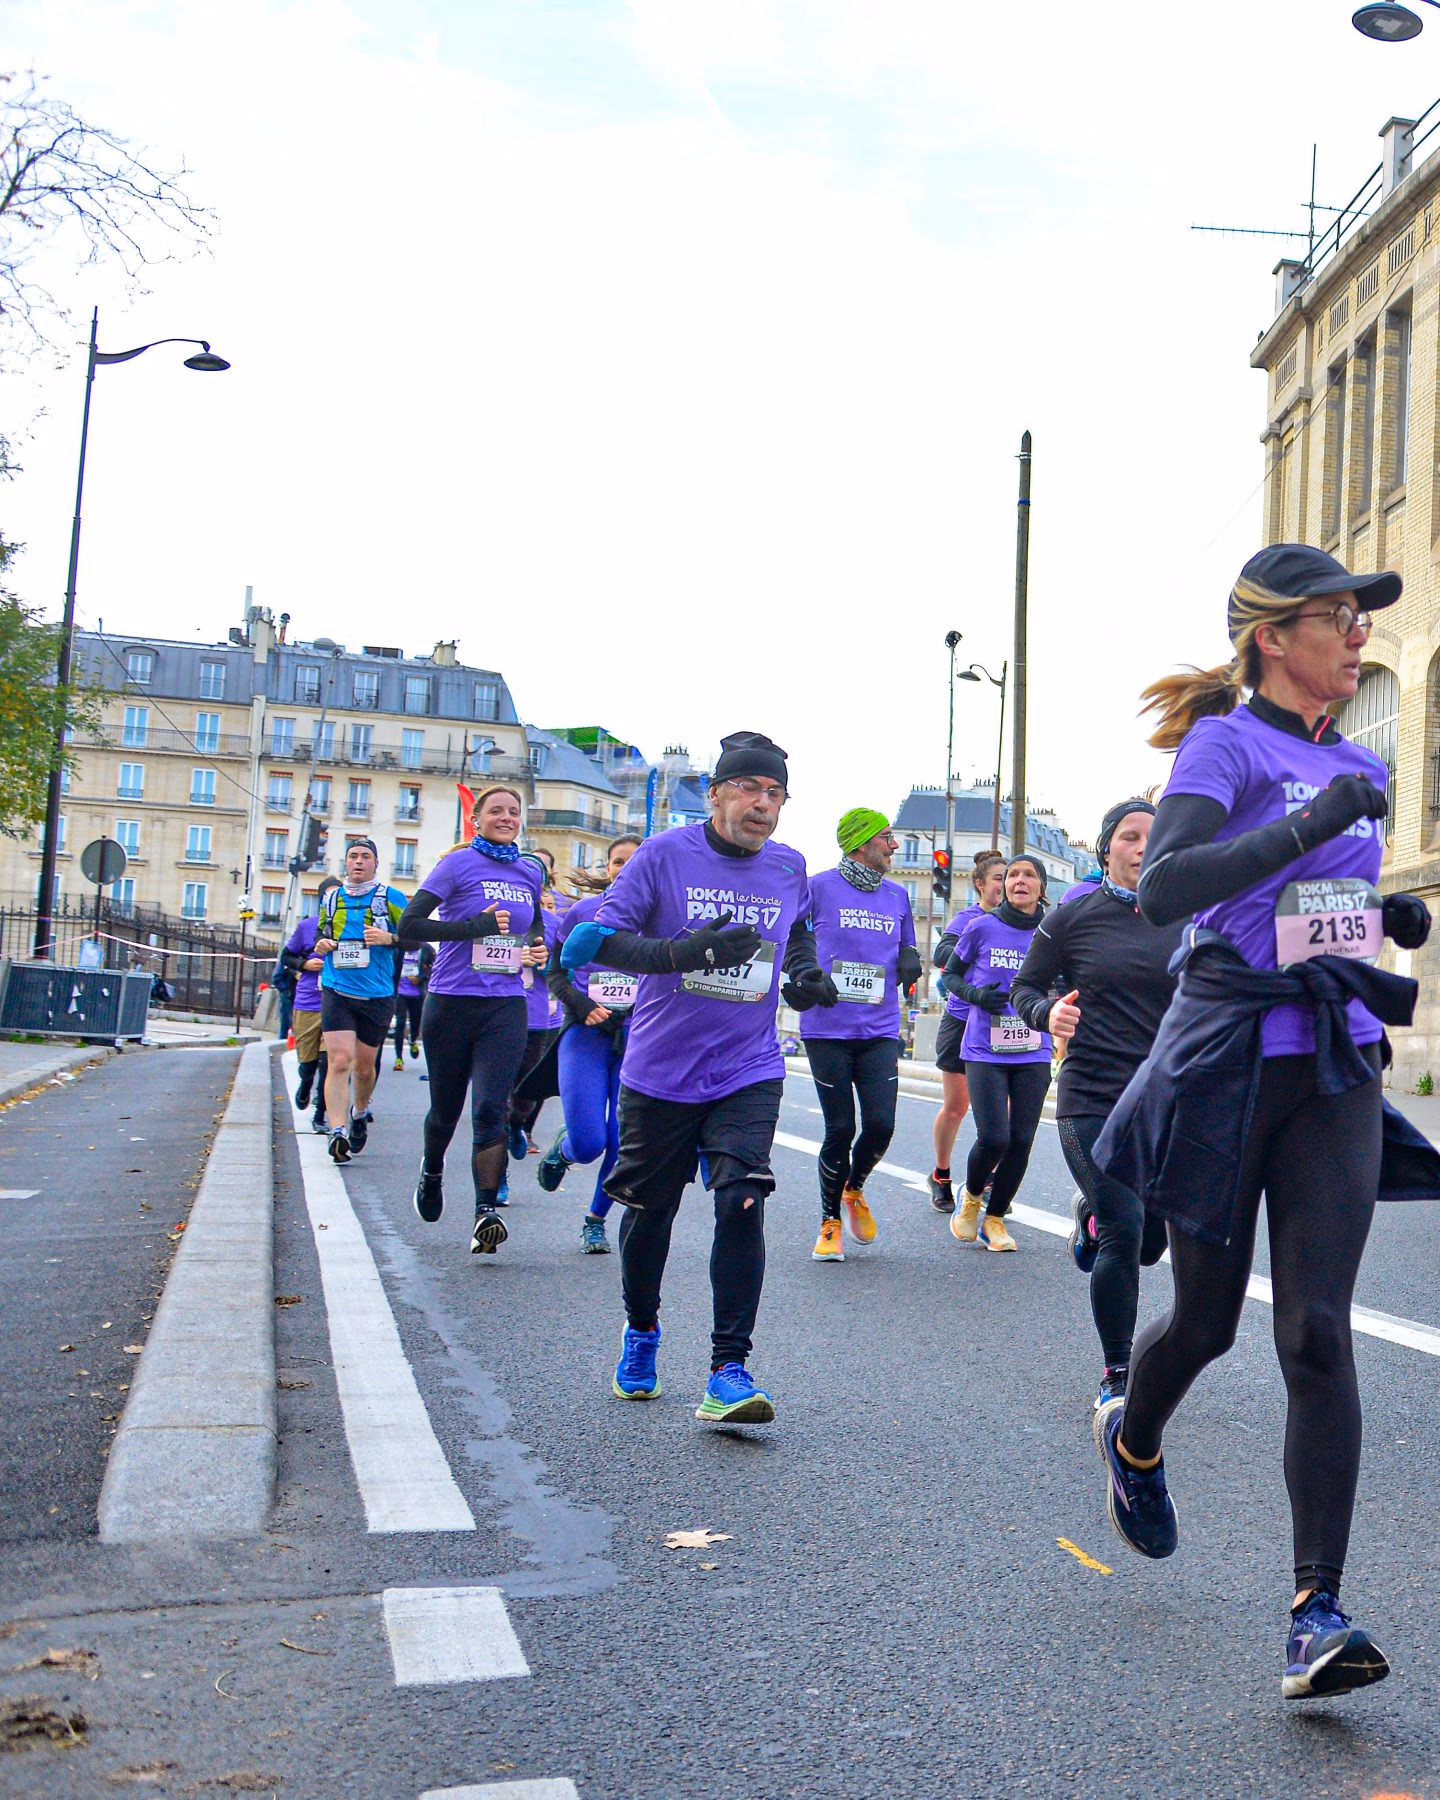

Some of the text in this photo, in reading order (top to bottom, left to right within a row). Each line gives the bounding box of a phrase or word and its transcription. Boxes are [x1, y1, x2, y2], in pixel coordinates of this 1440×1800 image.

[481, 881, 509, 890] 10KM
[1296, 882, 1334, 896] 10KM
[484, 888, 532, 906] PARIS17
[686, 887, 783, 906] 10KM les boucles
[1298, 891, 1367, 914] PARIS17
[687, 901, 781, 930] PARIS17
[839, 908, 868, 917] 10KM
[840, 917, 896, 935] PARIS17
[1309, 916, 1366, 945] 2135
[341, 951, 360, 959] 1562
[486, 947, 512, 959] 2271
[990, 948, 1018, 958] 10KM
[841, 967, 878, 977] PARIS17
[845, 976, 873, 989] 1446
[602, 986, 631, 997] 2274
[1003, 1028, 1030, 1040] 2159
